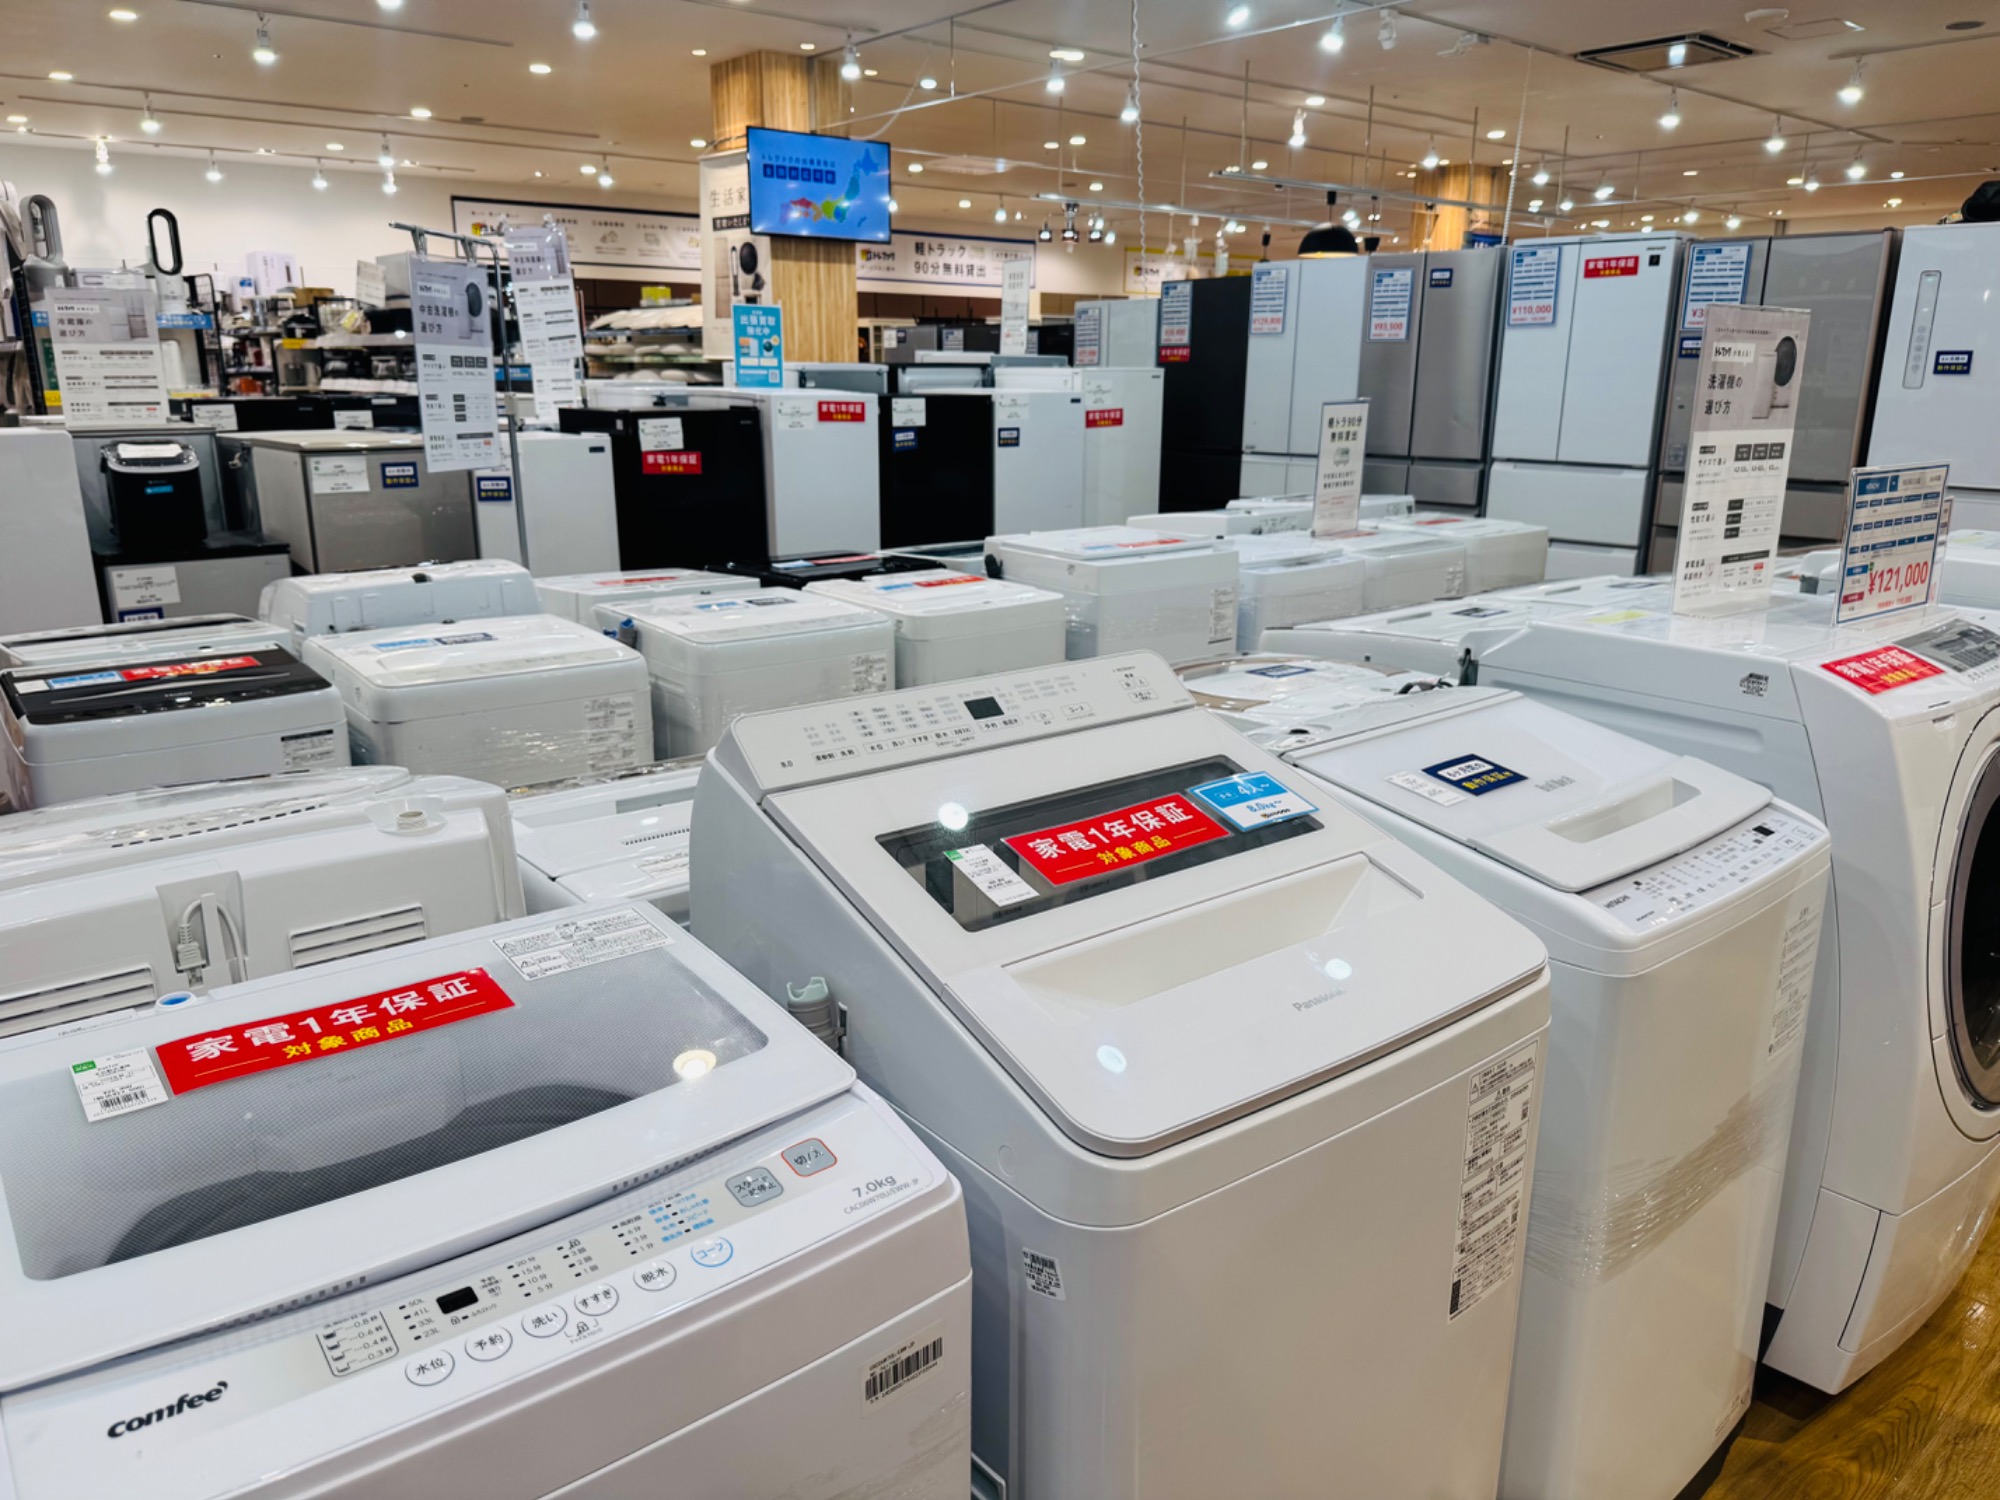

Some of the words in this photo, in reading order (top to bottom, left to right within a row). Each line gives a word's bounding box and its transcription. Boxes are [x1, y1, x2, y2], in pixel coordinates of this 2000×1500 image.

[914, 241, 966, 258] 軽トラック
[914, 261, 987, 278] 90分無料貸出
[1512, 304, 1552, 315] ¥110,000
[1707, 373, 1743, 390] 洗濯機の
[1704, 399, 1732, 415] 選び方
[646, 453, 698, 465] 家電1年保証
[1867, 560, 1929, 595] ¥121,000
[1027, 801, 1194, 860] 家電1年保証
[1096, 835, 1172, 865] 対象商品
[185, 976, 479, 1064] 家電1年保証
[283, 1017, 415, 1060] 対象商品
[852, 1174, 898, 1199] 7.0kg
[695, 1242, 724, 1260] コース
[522, 1264, 541, 1276] 15分
[641, 1267, 669, 1283] 脱水
[527, 1273, 547, 1285] 10分
[578, 1288, 612, 1309] すすぎ
[531, 1312, 558, 1329] 洗い
[424, 1327, 440, 1338] 23L
[474, 1334, 504, 1351] 予約
[416, 1357, 446, 1376] 水位
